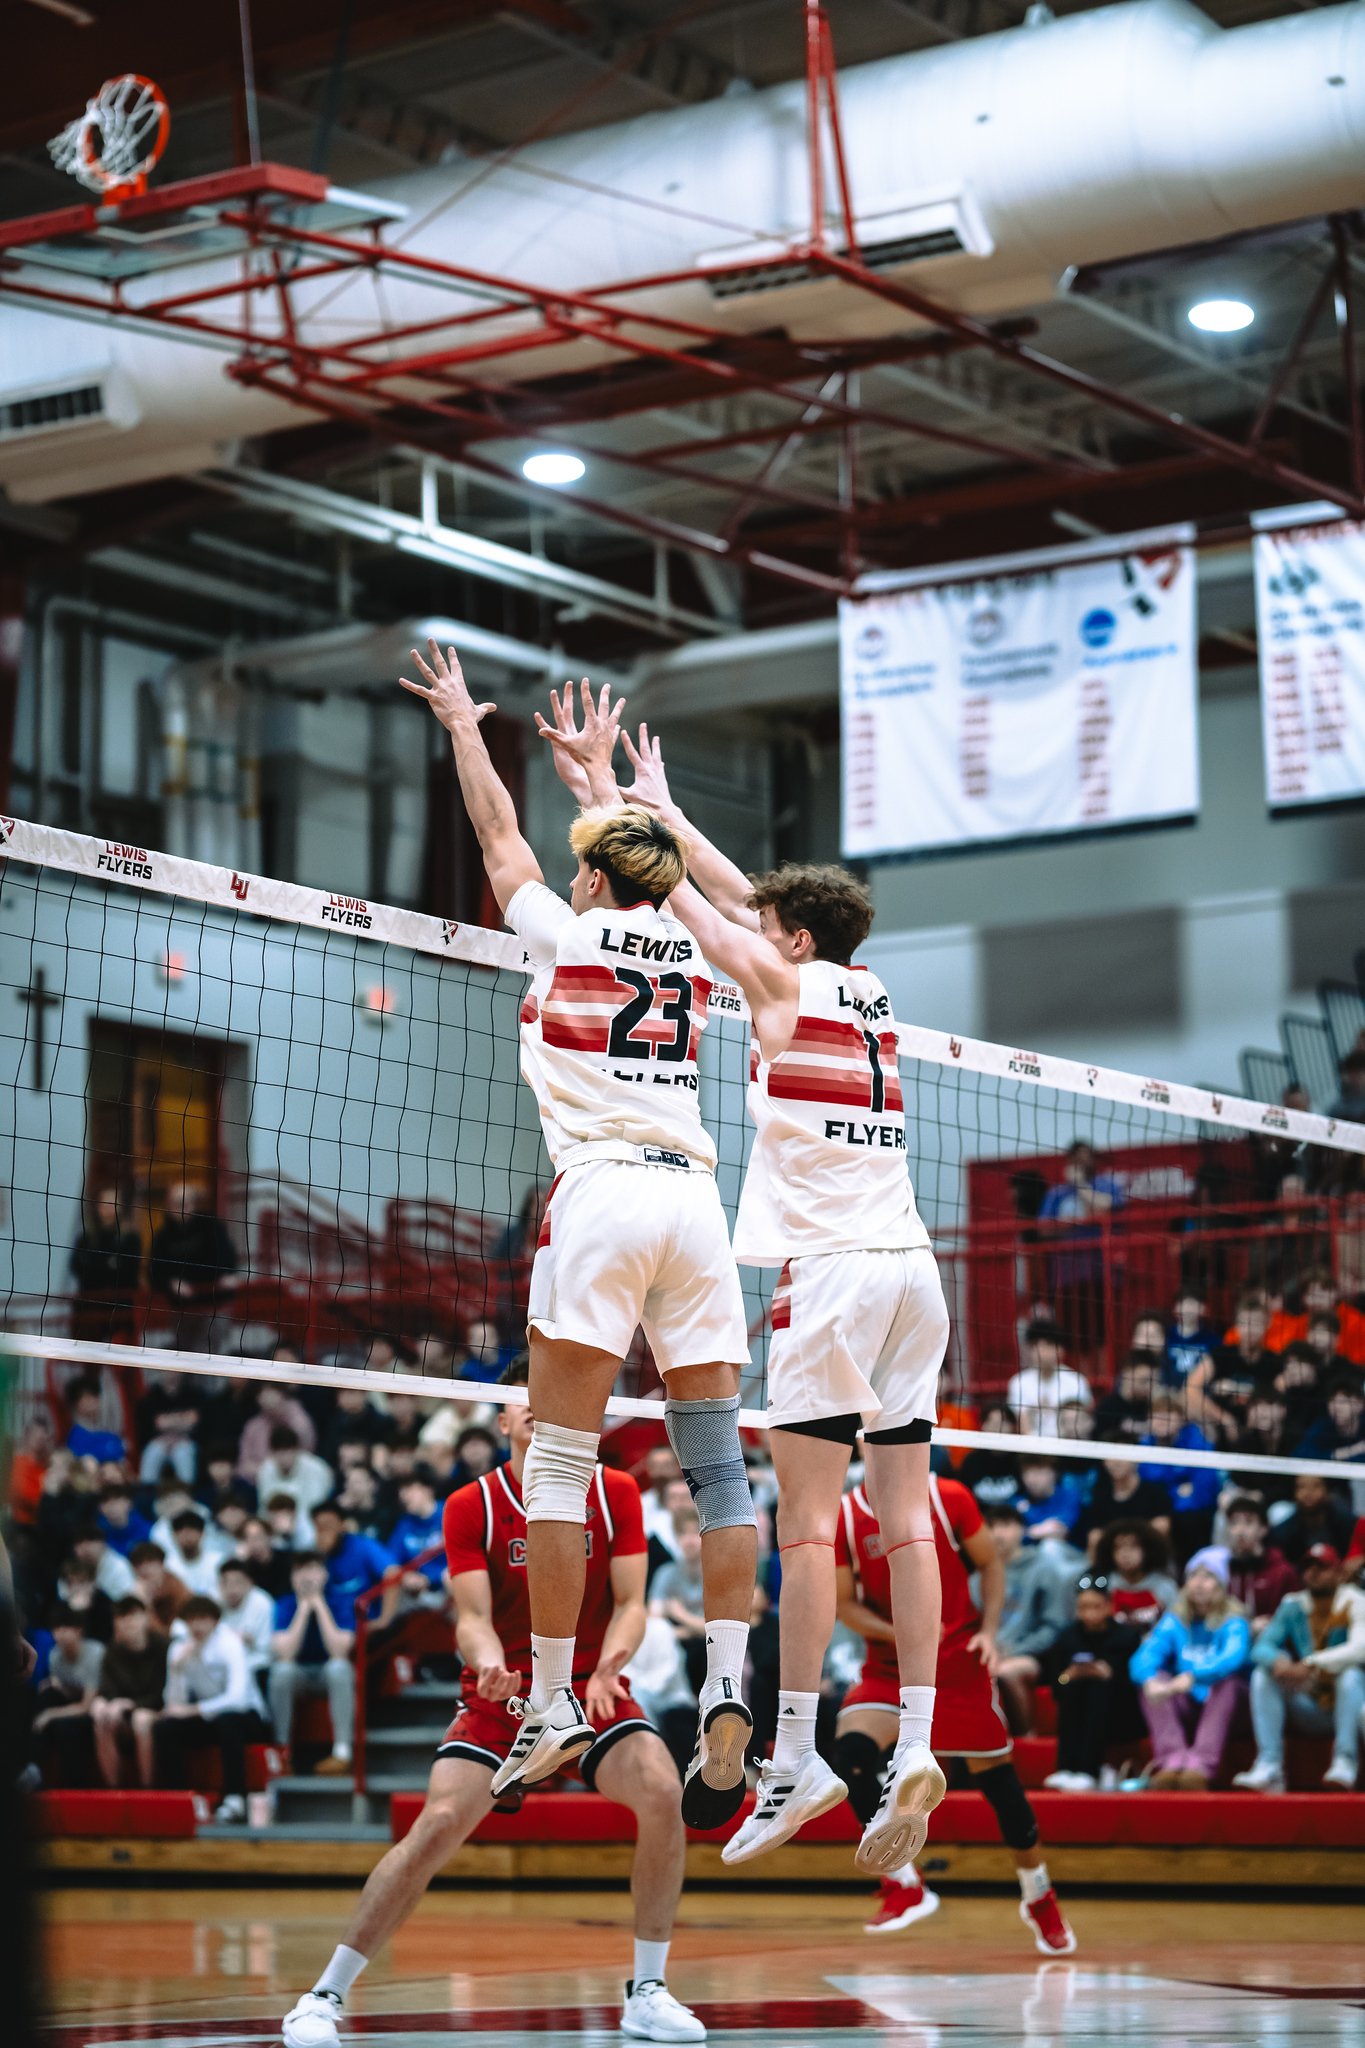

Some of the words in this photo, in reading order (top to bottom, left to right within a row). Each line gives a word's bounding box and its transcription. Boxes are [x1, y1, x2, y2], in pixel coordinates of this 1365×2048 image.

[105, 841, 148, 862] LEWIS
[97, 854, 153, 880] FLYERS
[328, 894, 367, 913] LEWIS
[321, 906, 372, 930] FLYERS
[599, 927, 693, 963] LEWIS
[711, 982, 738, 997] EWIS
[708, 994, 741, 1012] LYERS
[607, 966, 693, 1063] 23
[863, 1030, 884, 1113] 1
[1008, 1060, 1041, 1078] FLYERS
